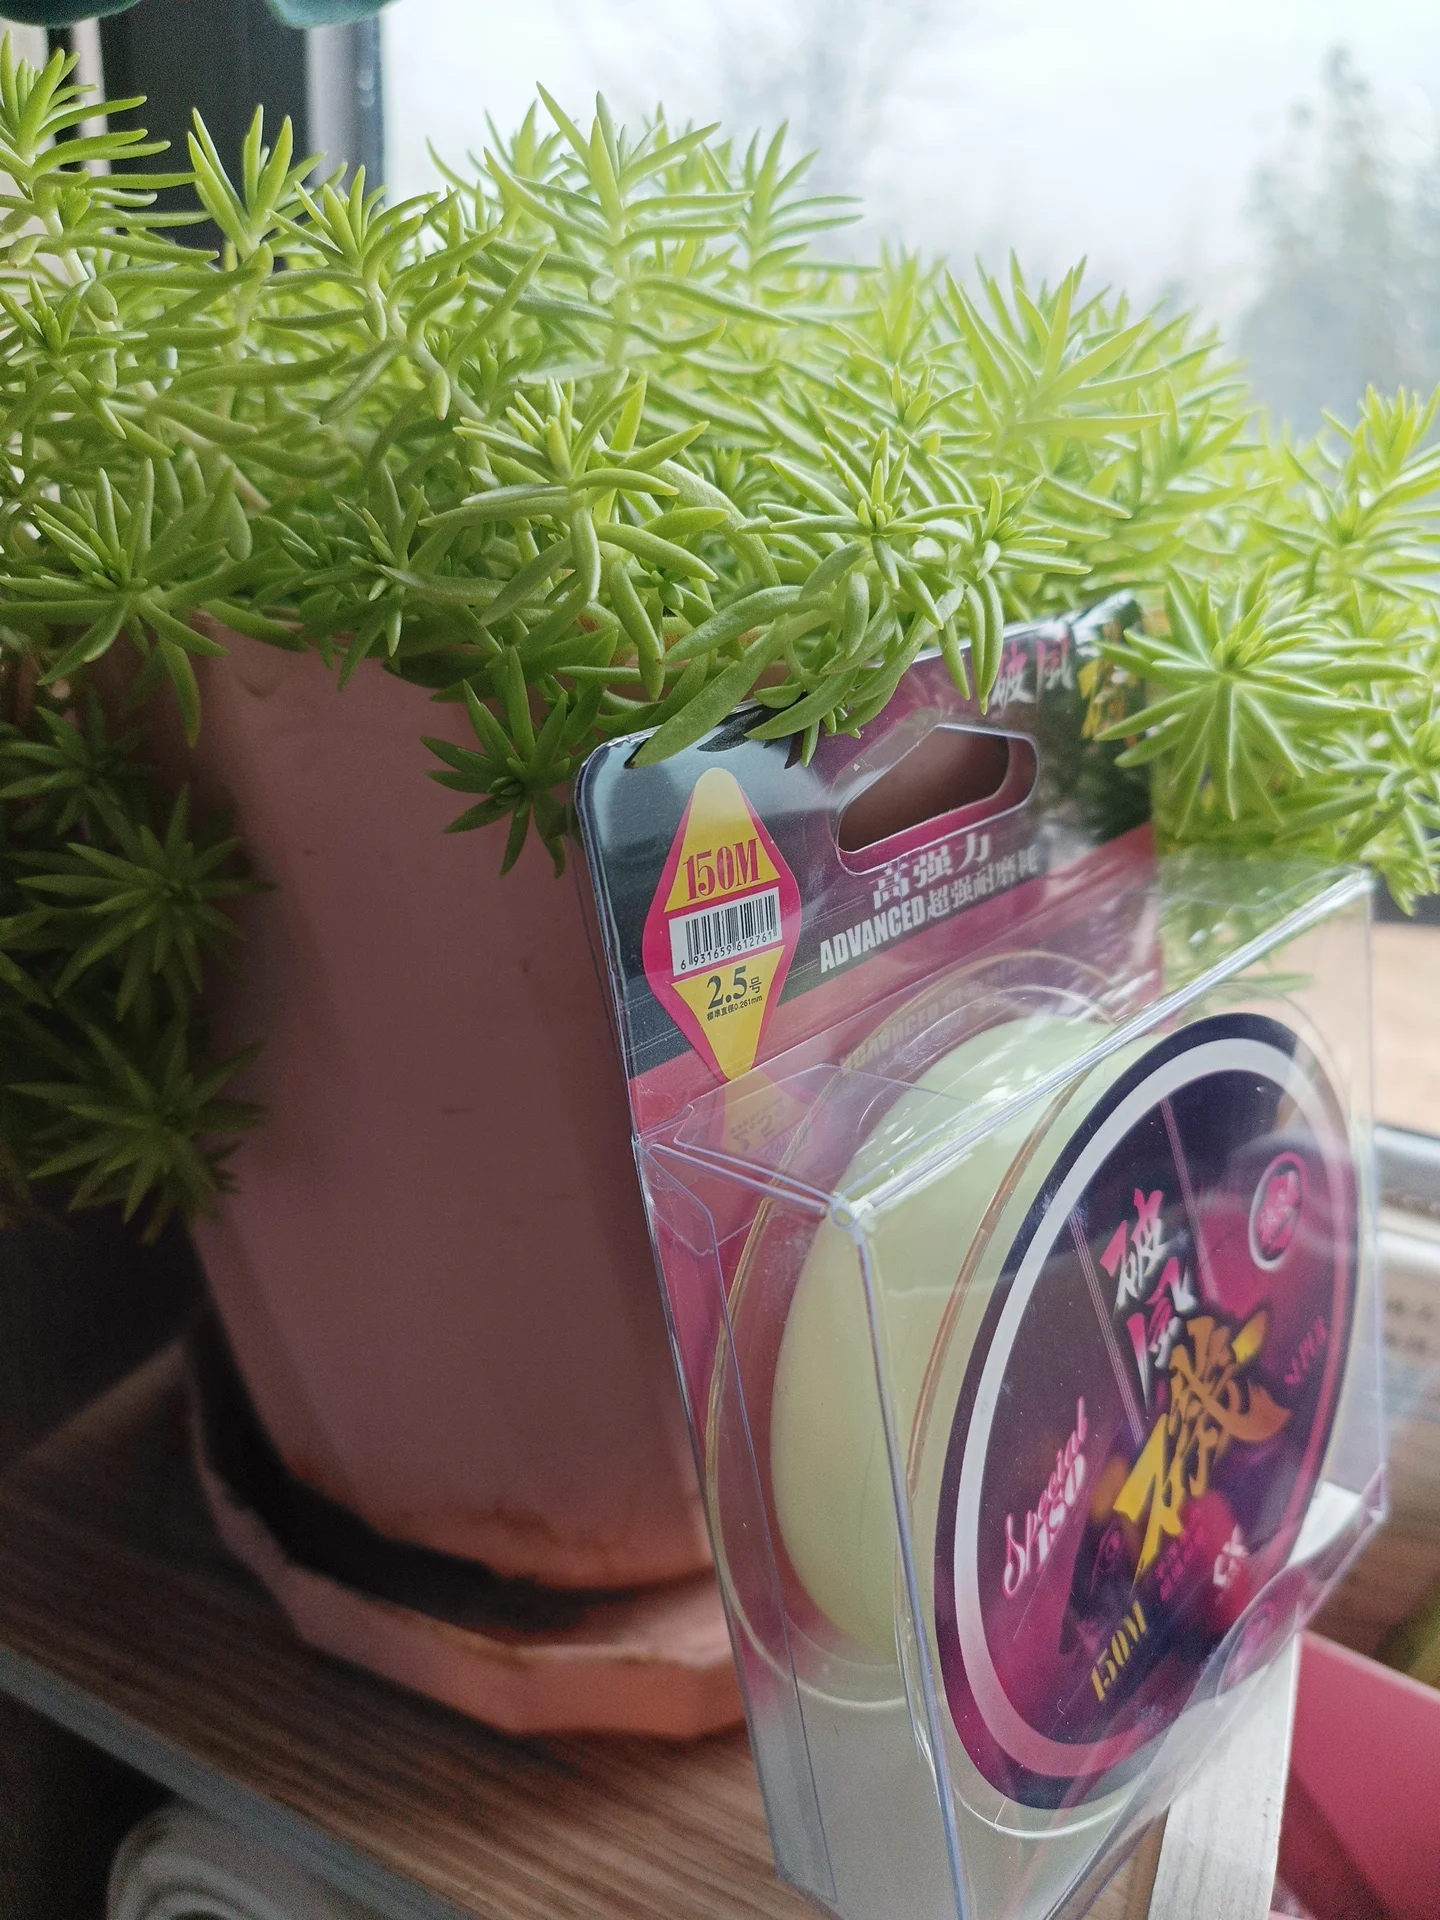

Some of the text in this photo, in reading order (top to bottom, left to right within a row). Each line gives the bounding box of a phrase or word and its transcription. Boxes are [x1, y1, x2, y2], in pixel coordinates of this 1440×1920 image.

[683, 837, 761, 902] 150M
[870, 832, 991, 910] 高强力
[820, 895, 926, 974] ADVANCED
[1091, 1600, 1148, 1702] 150M
